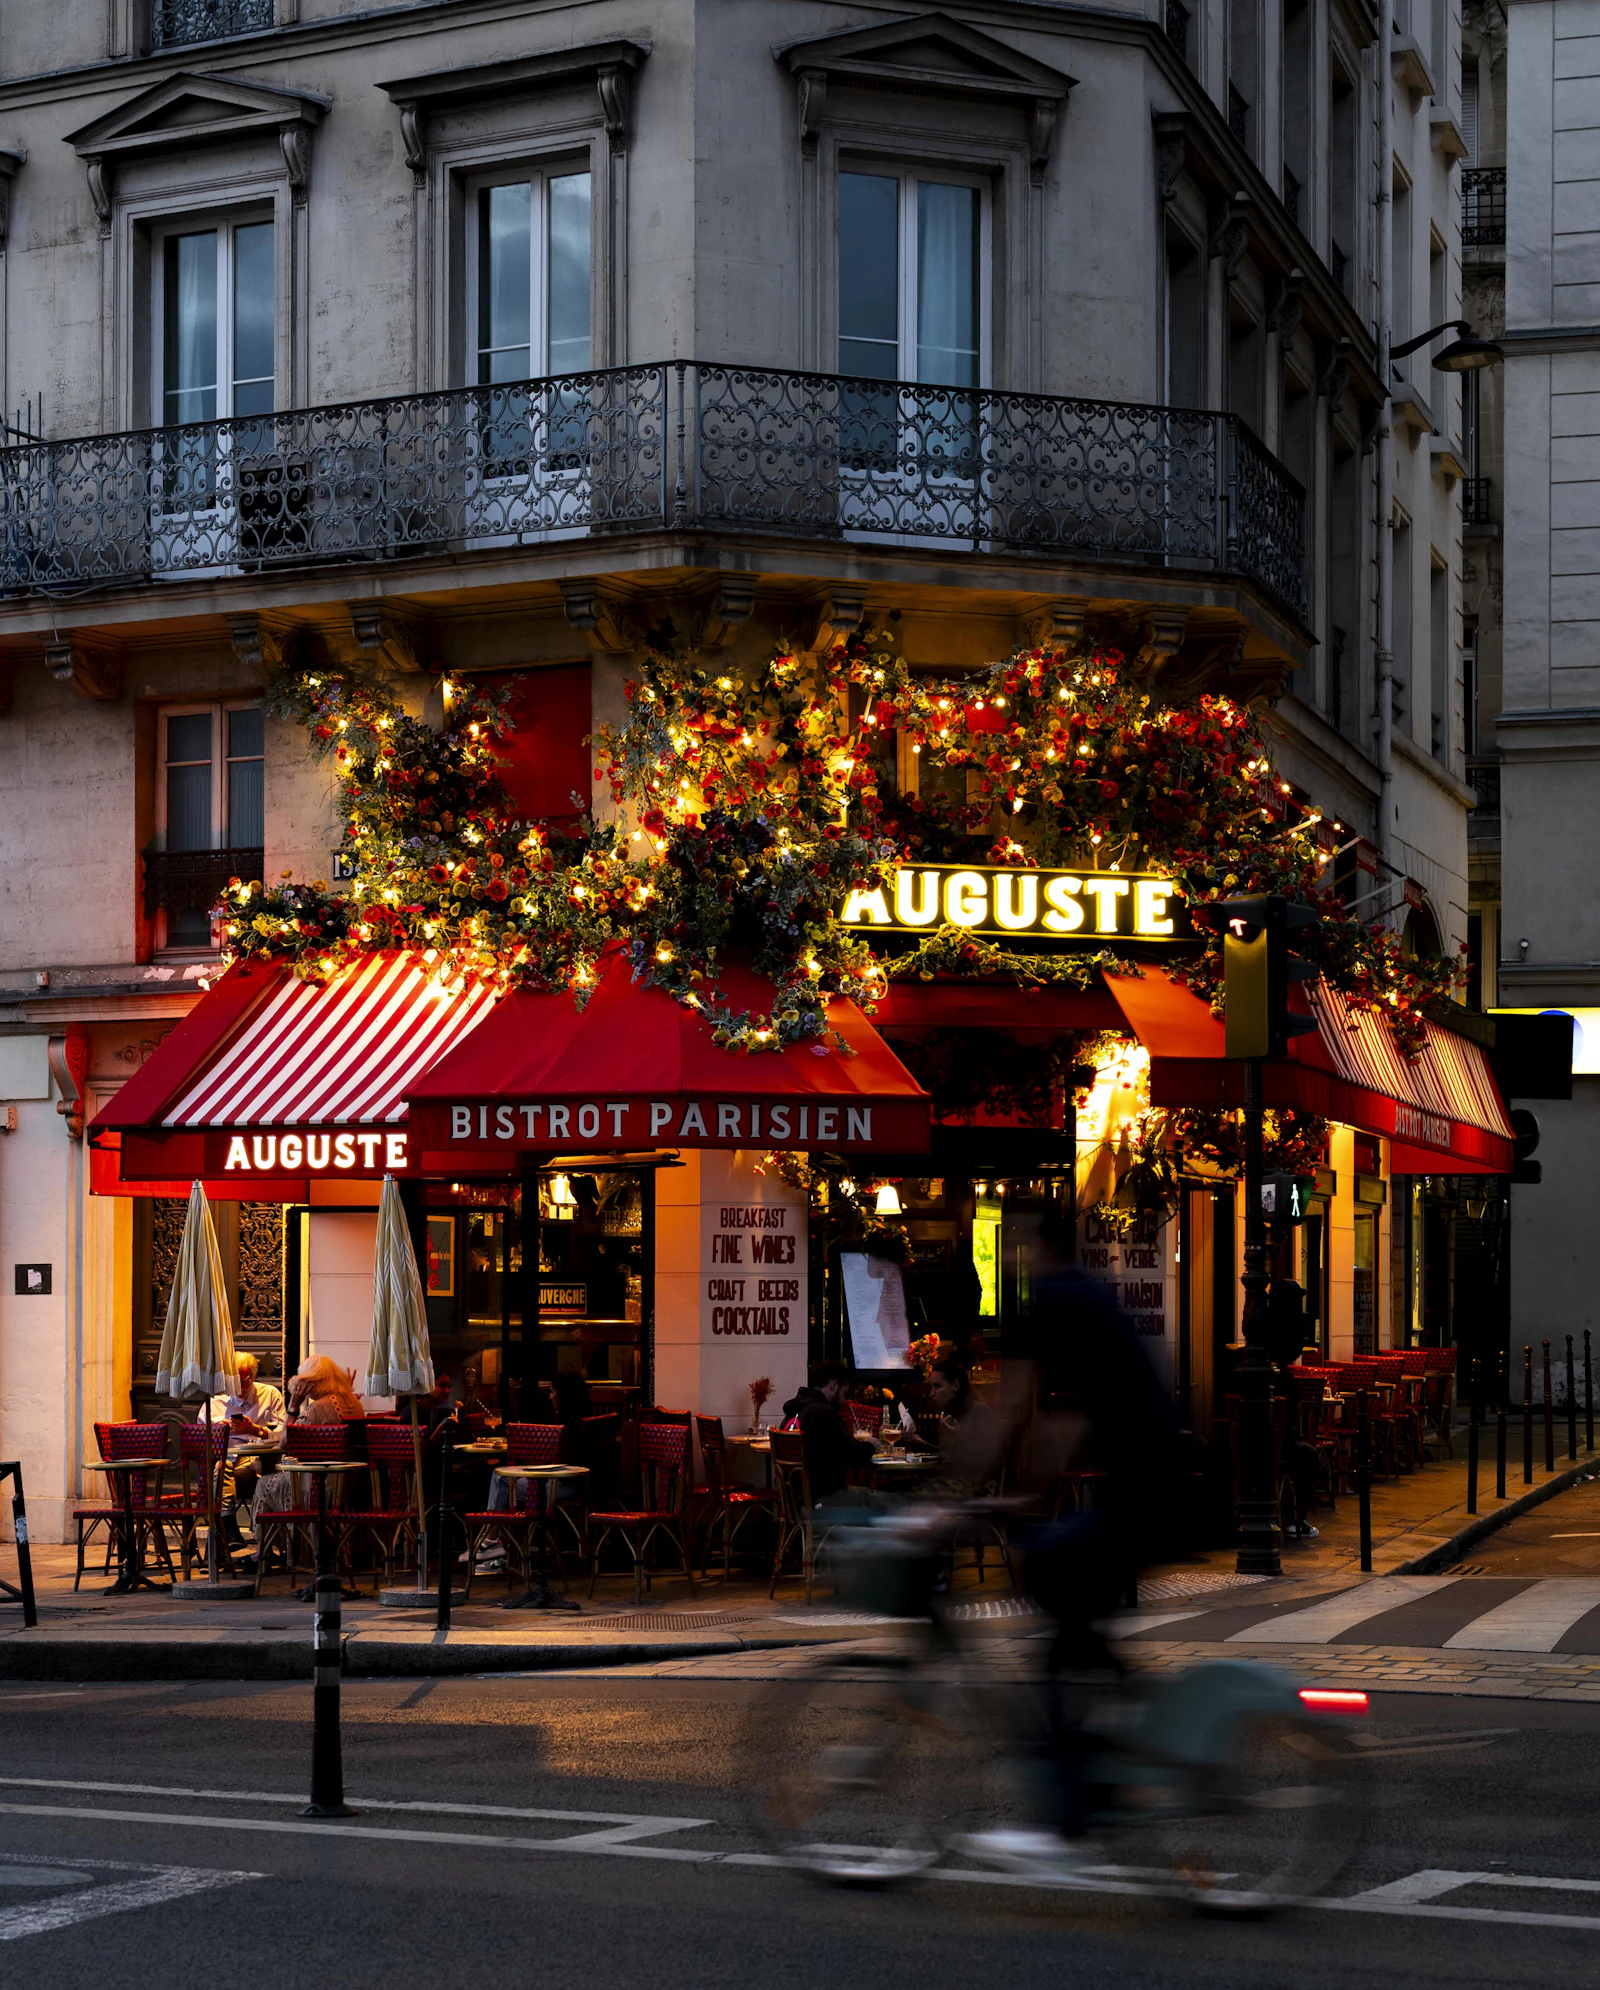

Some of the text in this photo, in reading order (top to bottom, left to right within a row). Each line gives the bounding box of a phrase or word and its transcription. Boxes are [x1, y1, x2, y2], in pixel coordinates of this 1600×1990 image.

[841, 870, 1174, 934] AUGUSTE
[451, 1102, 873, 1142] BISTROT PARISIEN
[1395, 1104, 1450, 1148] BISTROT PARISIEN
[224, 1133, 408, 1171] AUGUSTE
[720, 1208, 787, 1228] BREAKFAST
[712, 1234, 796, 1264] FINE WINES
[1081, 1249, 1108, 1269] VINS
[1124, 1249, 1158, 1269] VERRE
[708, 1279, 799, 1302] CRAFT BEERS
[712, 1306, 790, 1336] COCKTAILS
